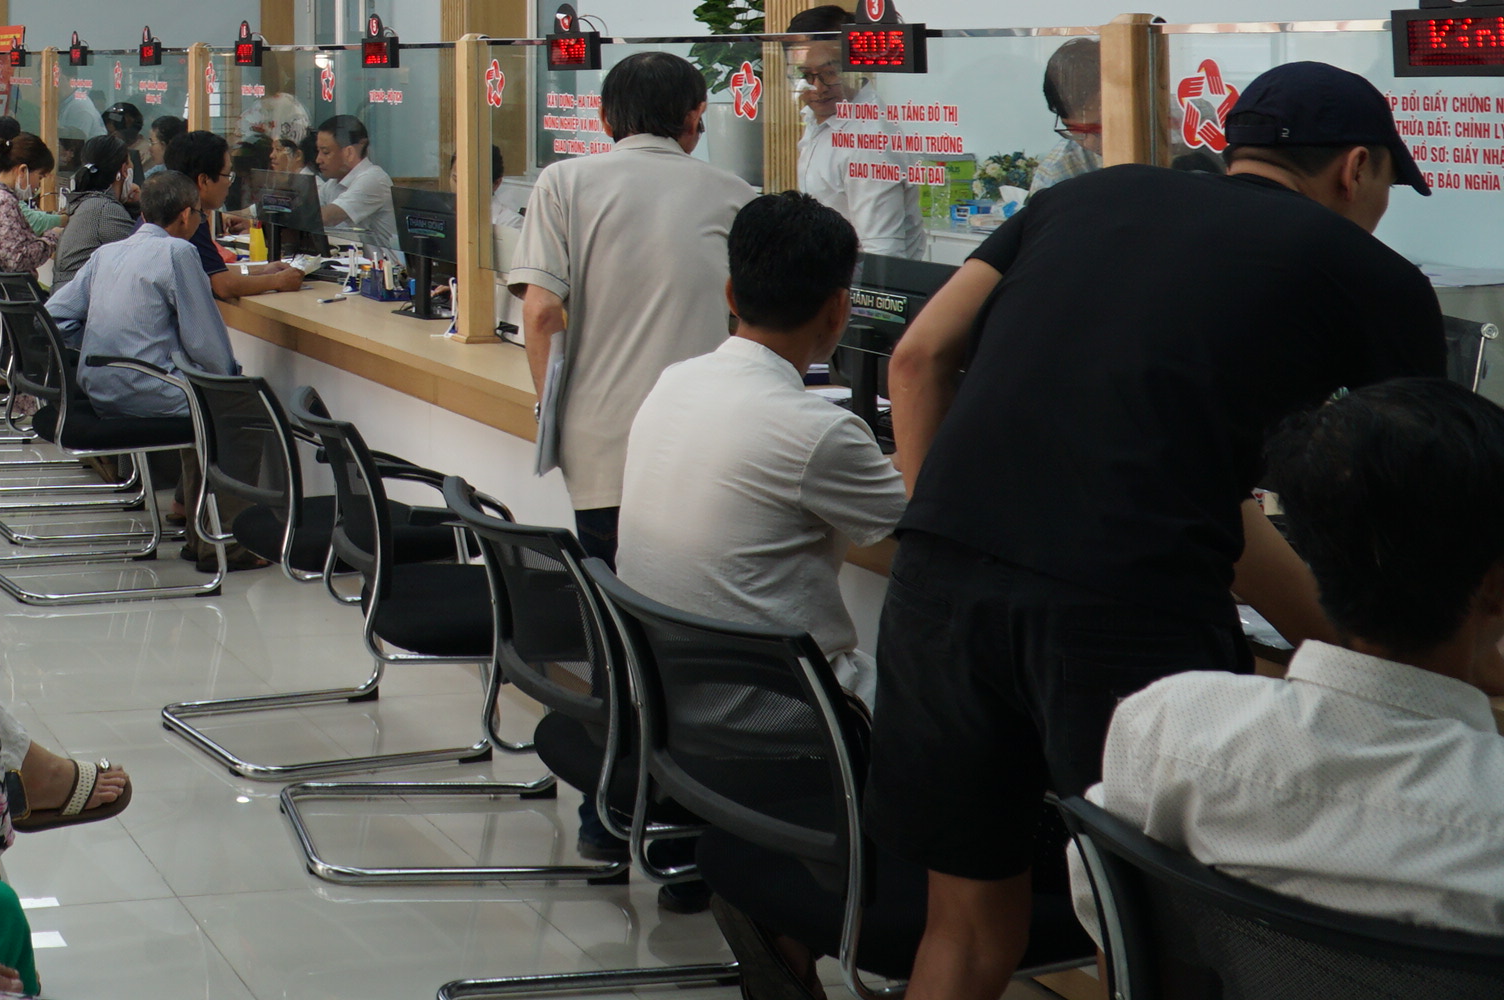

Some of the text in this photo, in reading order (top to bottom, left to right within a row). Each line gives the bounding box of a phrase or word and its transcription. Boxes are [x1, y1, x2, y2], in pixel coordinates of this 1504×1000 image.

[836, 100, 853, 119] XÂY
[855, 102, 878, 123] DỰNG
[887, 105, 899, 125] HẠ
[927, 101, 940, 121] ĐÔ
[943, 105, 958, 126] THỊ
[1422, 90, 1448, 112] GIẤY
[1452, 93, 1491, 113] CHỨNG
[1395, 115, 1425, 136] THỬA
[1454, 117, 1490, 139] CHỈNH
[831, 129, 963, 153] NÔNG NGHIỆP VÀ MÔI TRƯỜNG
[1411, 140, 1428, 161] HỒ
[1430, 146, 1449, 163] SƠ:
[1453, 142, 1478, 164] GIẤY
[849, 162, 868, 178] GIAO
[871, 161, 900, 181] THÔNG
[908, 160, 925, 183] ĐẤT
[927, 167, 945, 184] ĐAI
[1437, 170, 1461, 189] BÁO
[1464, 172, 1501, 191] NGHĨA
[850, 291, 874, 307] HÁNH
